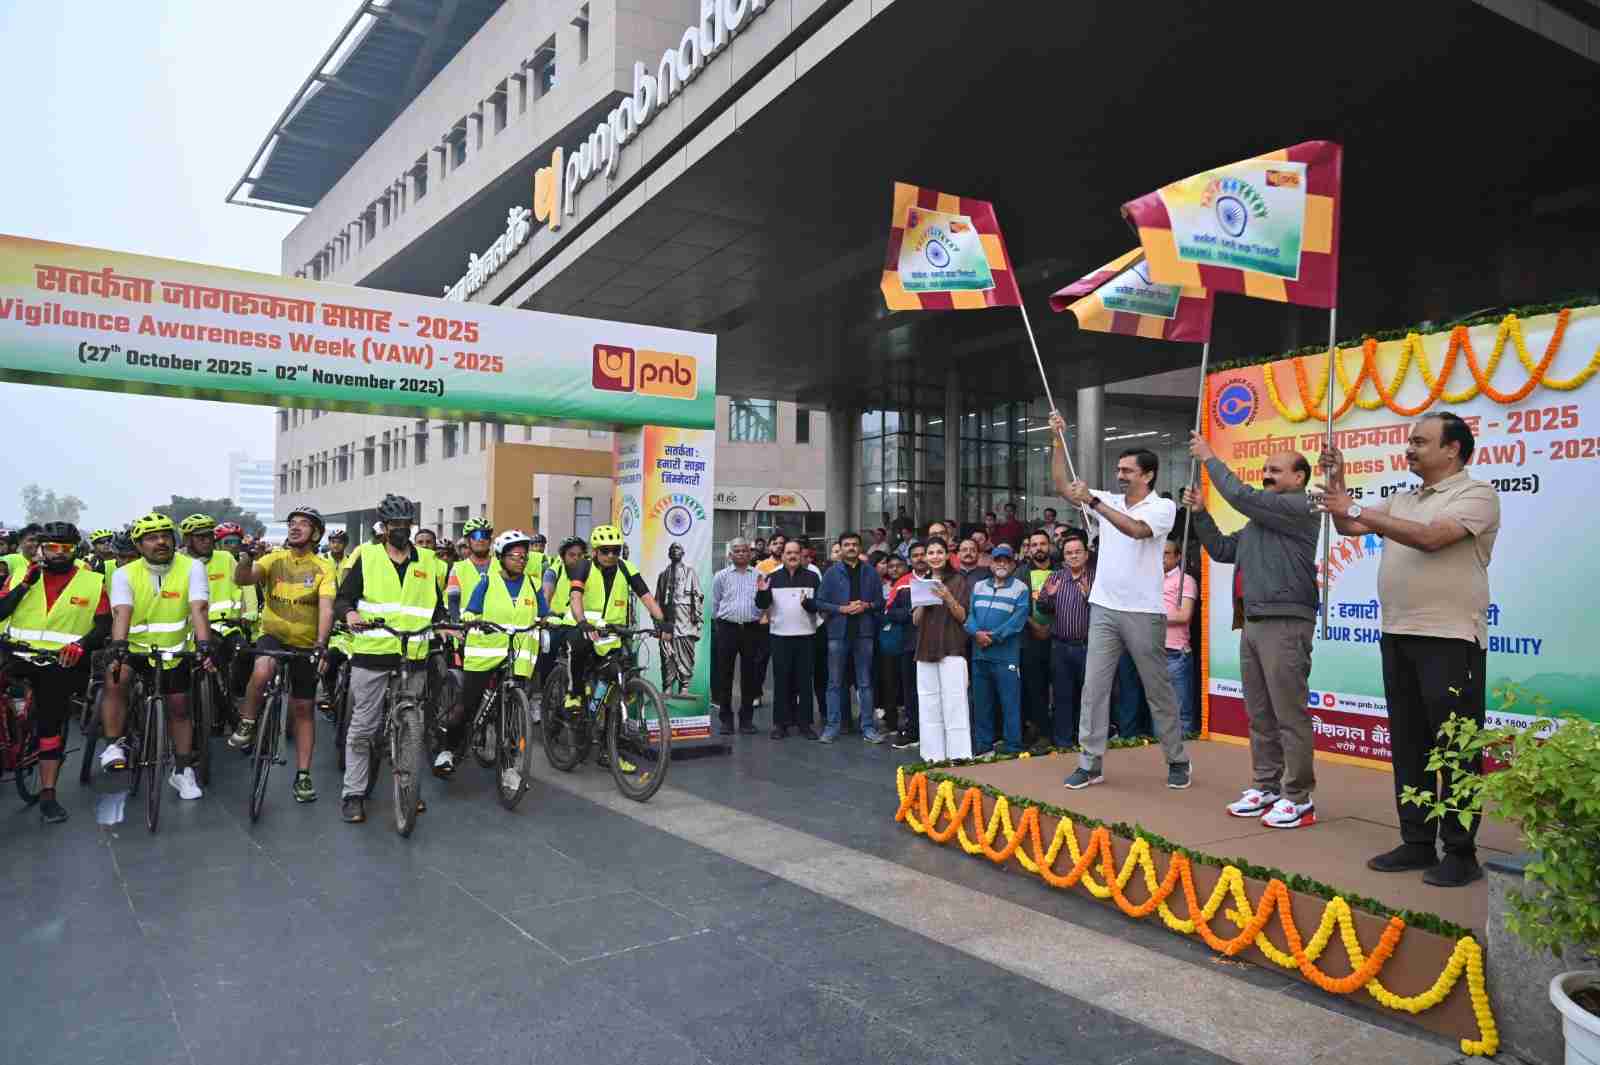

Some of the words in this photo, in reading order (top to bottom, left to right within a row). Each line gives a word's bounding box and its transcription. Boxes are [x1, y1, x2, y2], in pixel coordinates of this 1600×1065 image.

[34, 264, 155, 303] सतर्कता
[416, 315, 479, 343] 2025
[0, 297, 130, 332] Vigilance
[138, 314, 281, 349] Awareness
[289, 332, 356, 359] Week
[362, 336, 433, 369] (VAW)
[453, 351, 504, 373] 2025
[126, 350, 201, 371] October
[206, 358, 252, 376] 2025
[312, 369, 396, 390] November
[400, 377, 444, 397] 2025)
[640, 358, 692, 388] pnb
[1507, 404, 1579, 434] 2025
[1490, 473, 1540, 494] 2025)
[1338, 599, 1380, 620] हमारी
[1353, 628, 1382, 643] SHA
